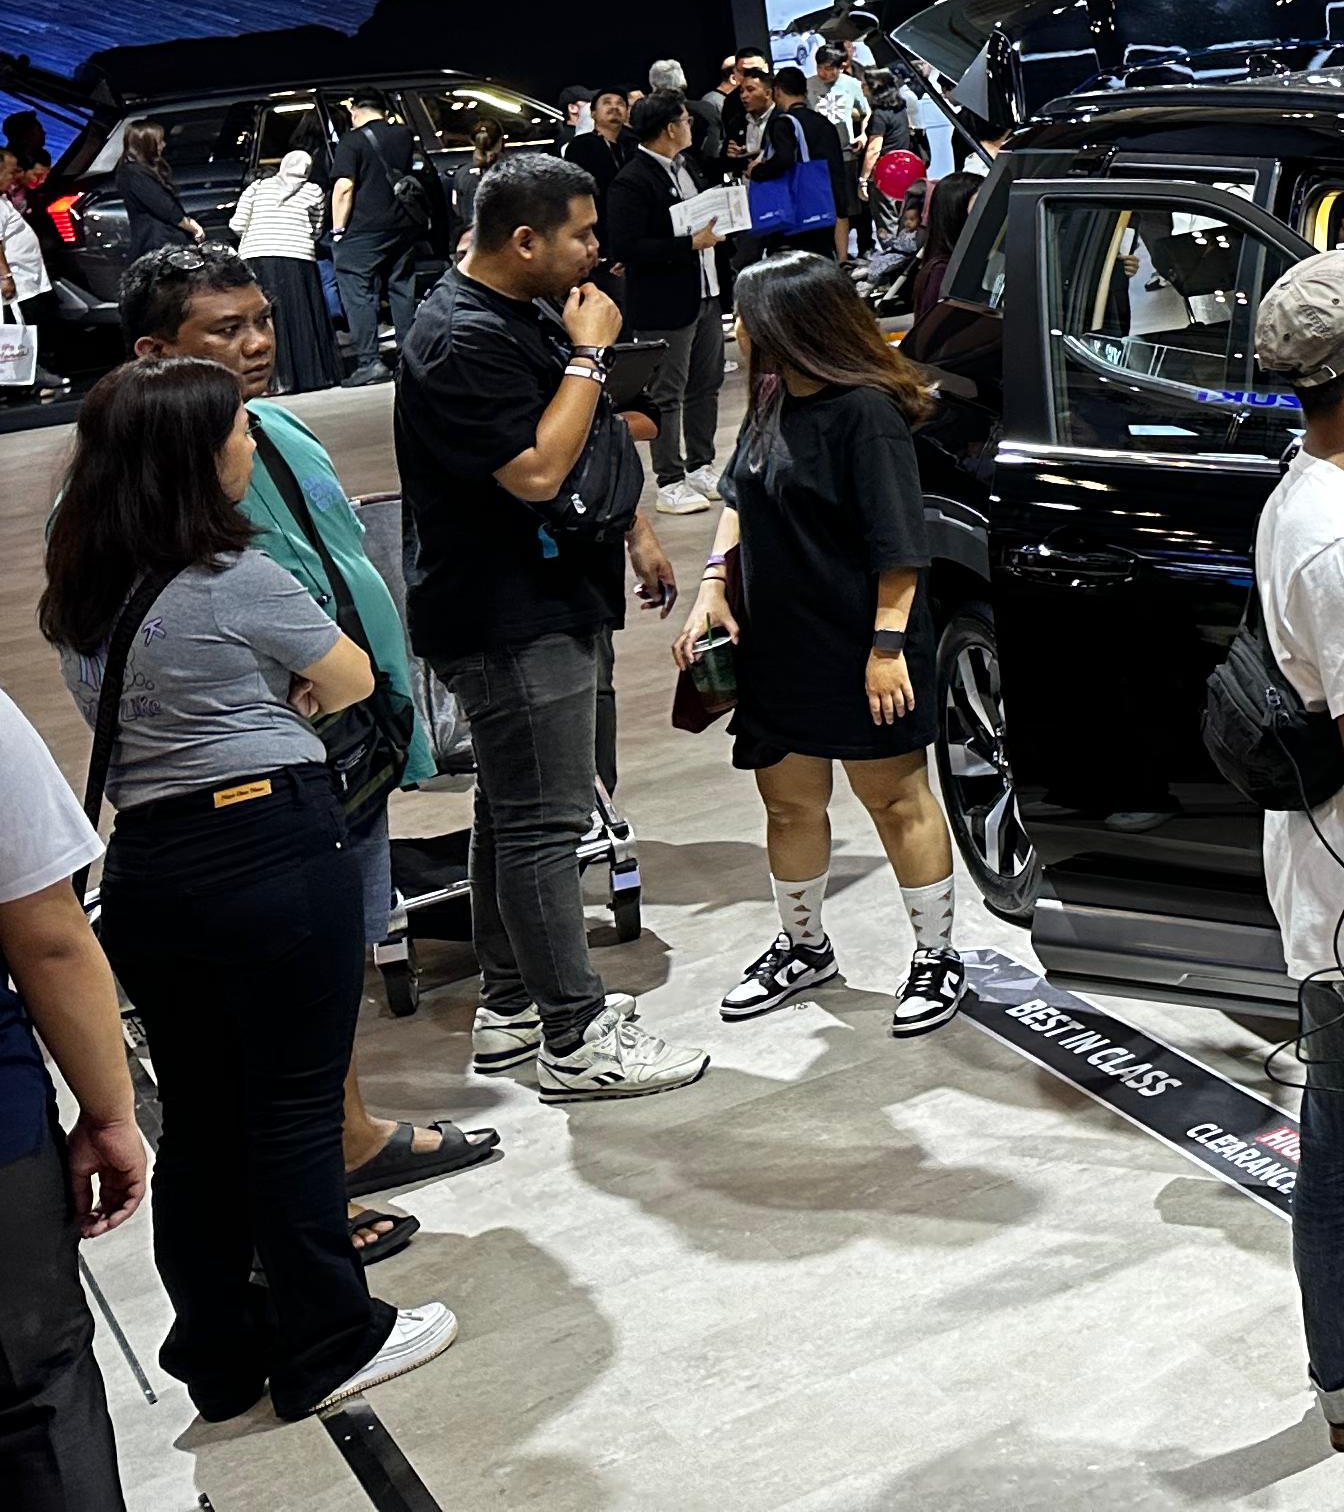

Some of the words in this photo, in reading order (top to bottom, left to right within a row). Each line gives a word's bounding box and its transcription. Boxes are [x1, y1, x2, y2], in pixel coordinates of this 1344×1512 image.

[1004, 998, 1085, 1038] BEST
[1058, 1030, 1111, 1055] IN
[1086, 1047, 1183, 1097] CLASS
